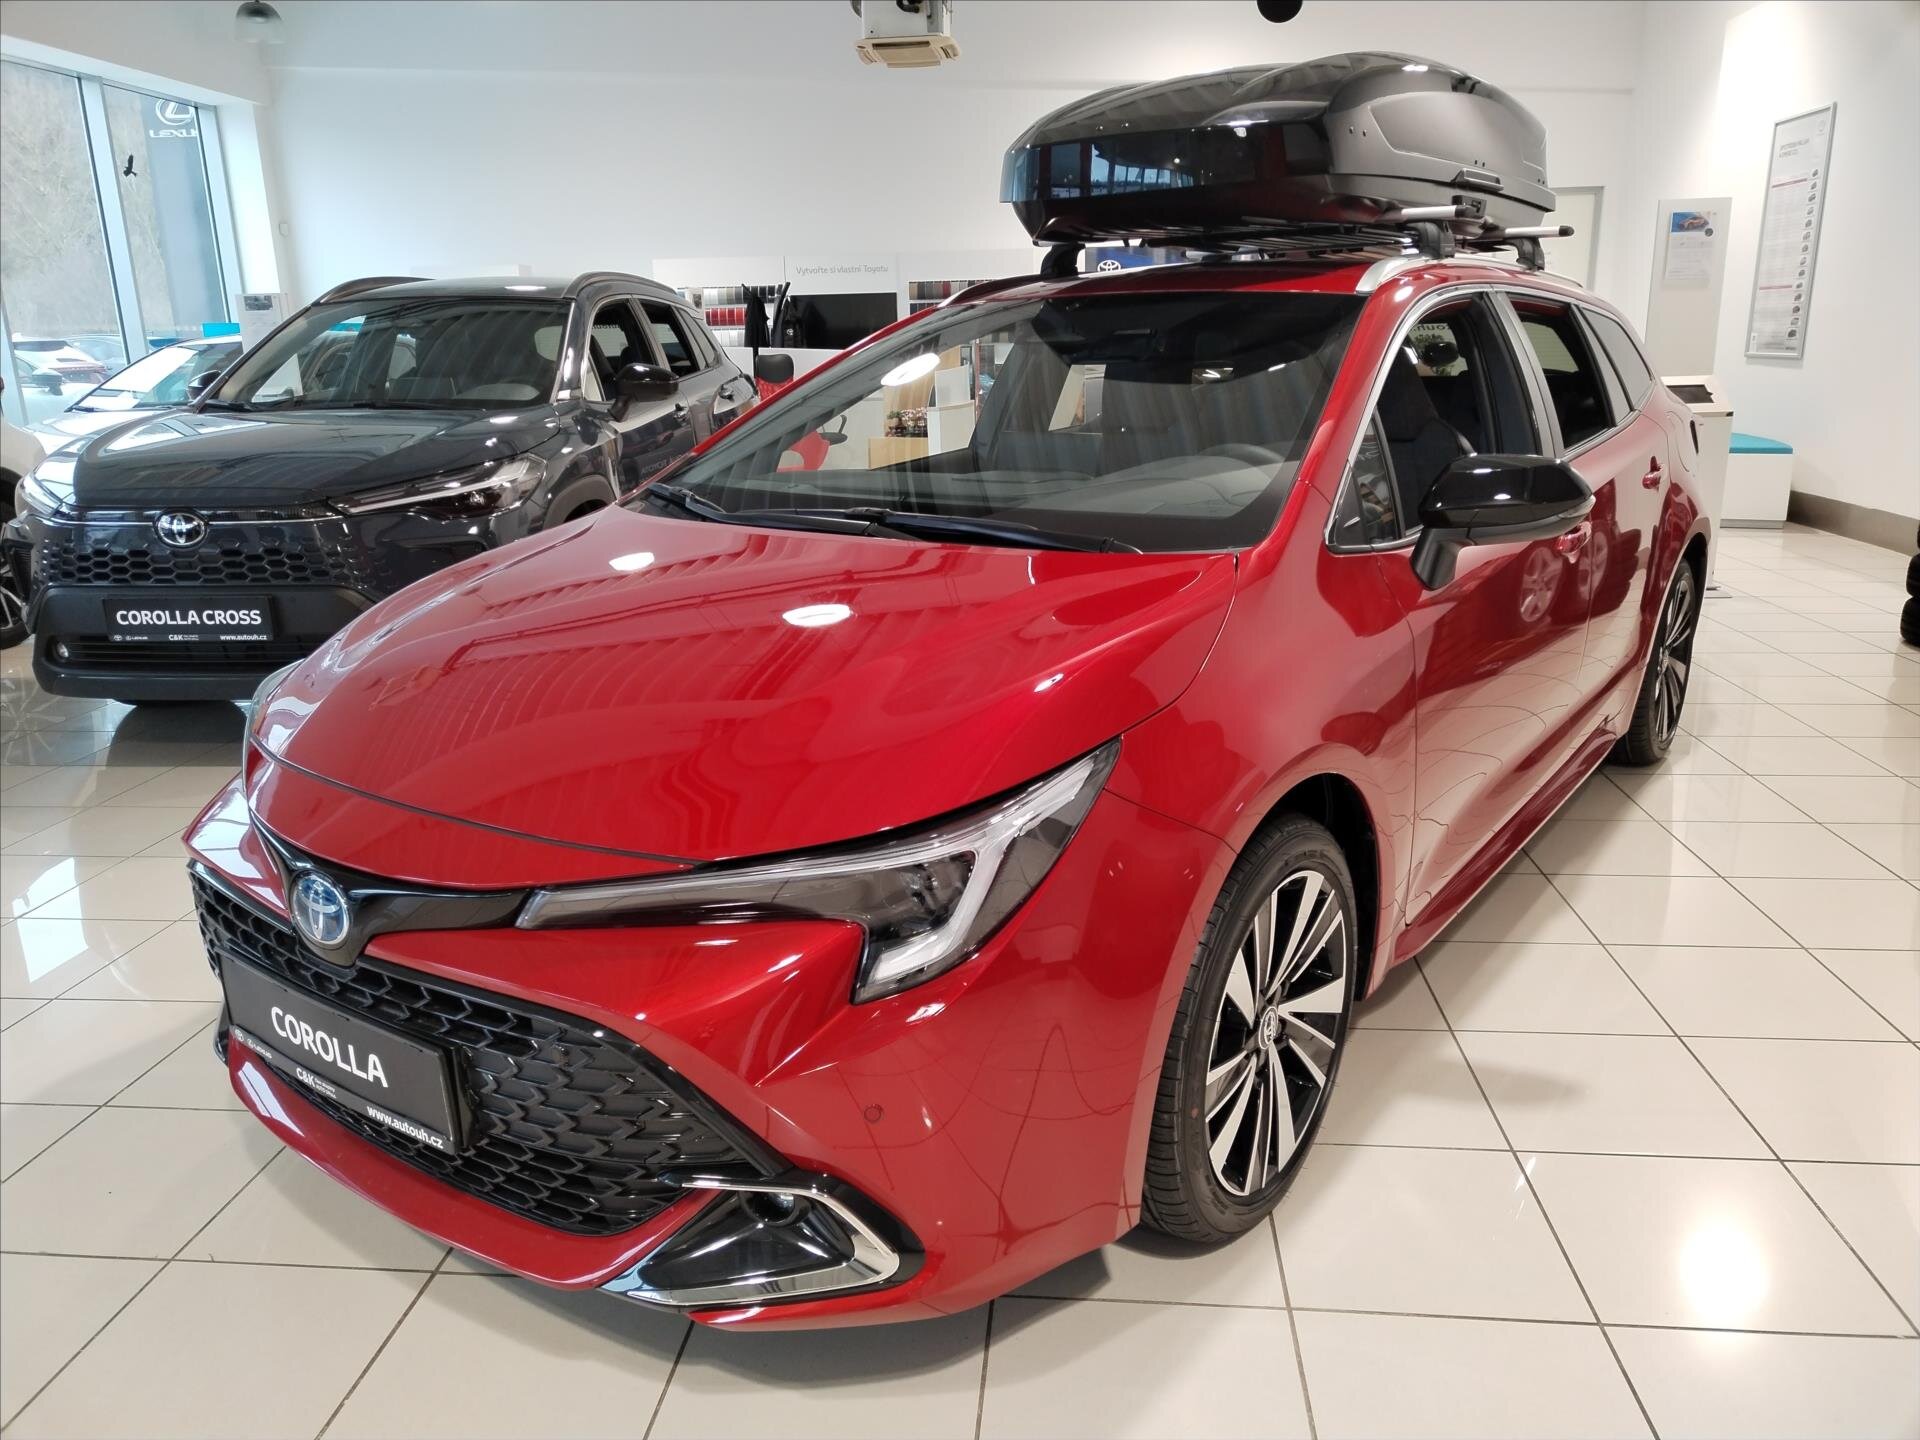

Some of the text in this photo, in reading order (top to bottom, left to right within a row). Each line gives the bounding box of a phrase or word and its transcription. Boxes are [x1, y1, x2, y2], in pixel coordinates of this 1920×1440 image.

[149, 129, 198, 138] LEXU
[116, 610, 262, 625] COROLLA CROSS
[271, 1006, 389, 1088] COROLLA
[296, 1067, 315, 1089] C&K
[366, 1105, 444, 1149] www.autouh.cz
